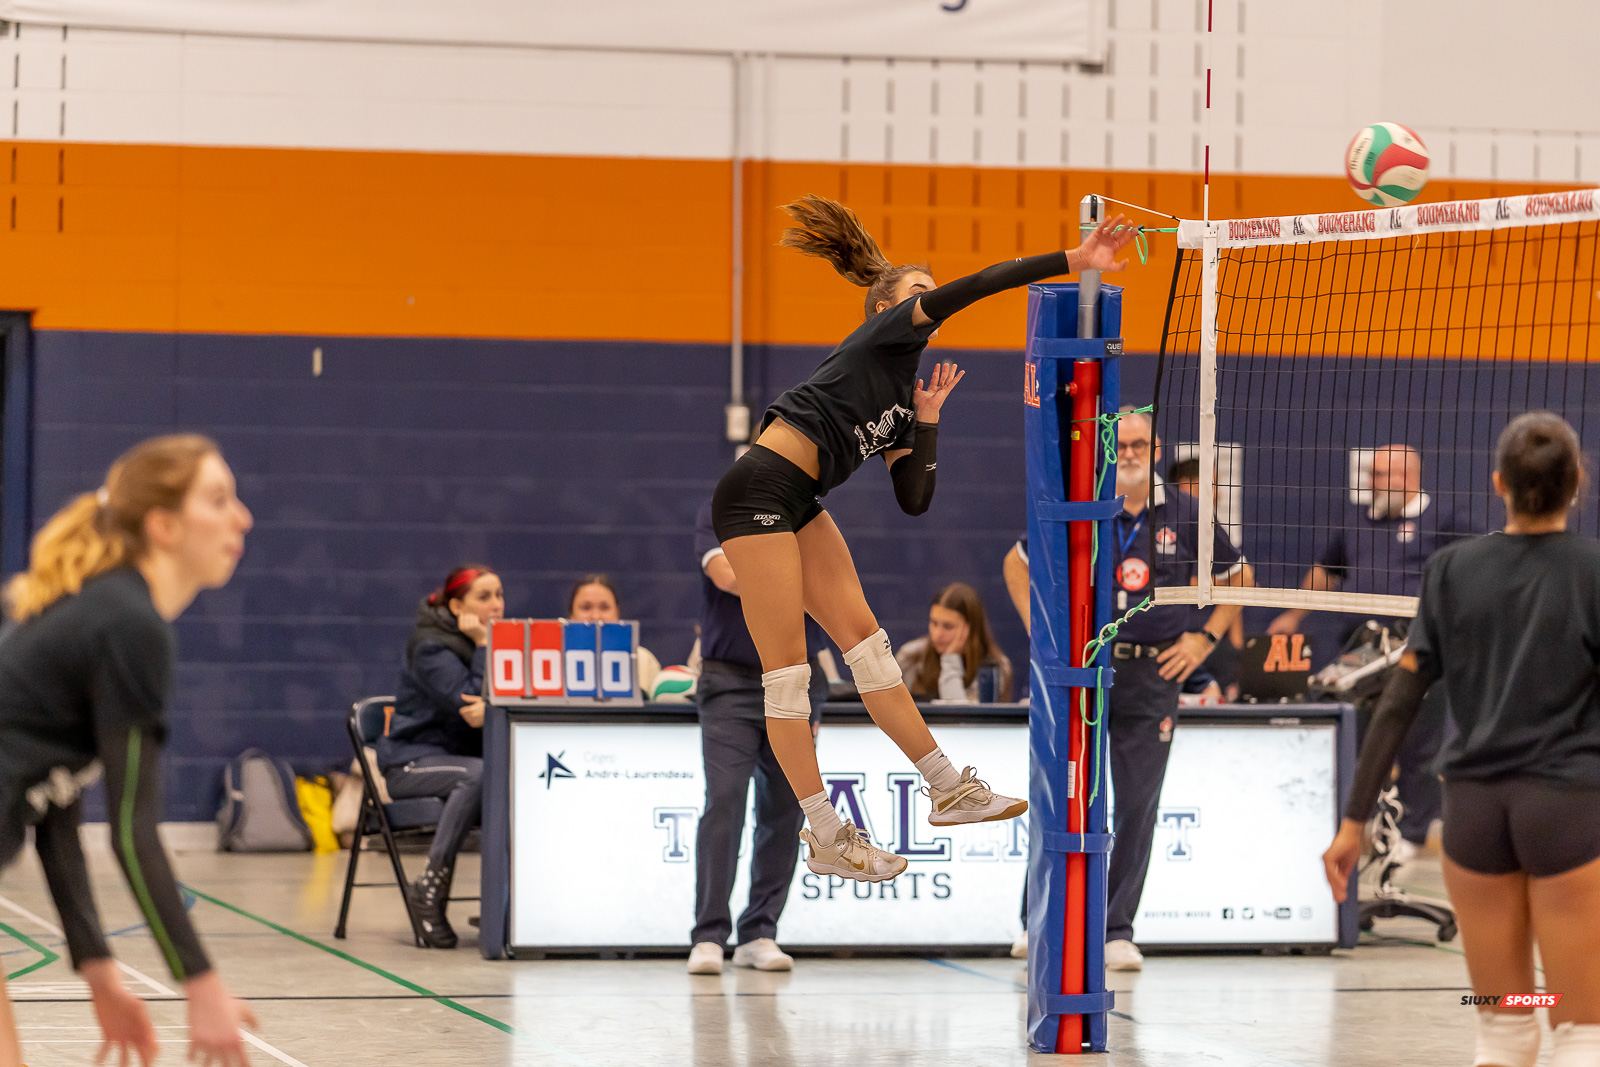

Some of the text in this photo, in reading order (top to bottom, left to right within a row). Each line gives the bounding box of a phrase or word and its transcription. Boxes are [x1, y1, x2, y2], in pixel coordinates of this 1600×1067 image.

[1228, 218, 1281, 240] BOOMERANG
[1317, 212, 1375, 234] BOOMERANG
[1417, 202, 1480, 226] BOOMERANG
[1525, 190, 1594, 217] BOOMERANG
[1024, 361, 1040, 409] AL
[1263, 633, 1311, 673] AL
[585, 770, 694, 779] André-Laurendeau
[802, 873, 951, 899] SPORTS
